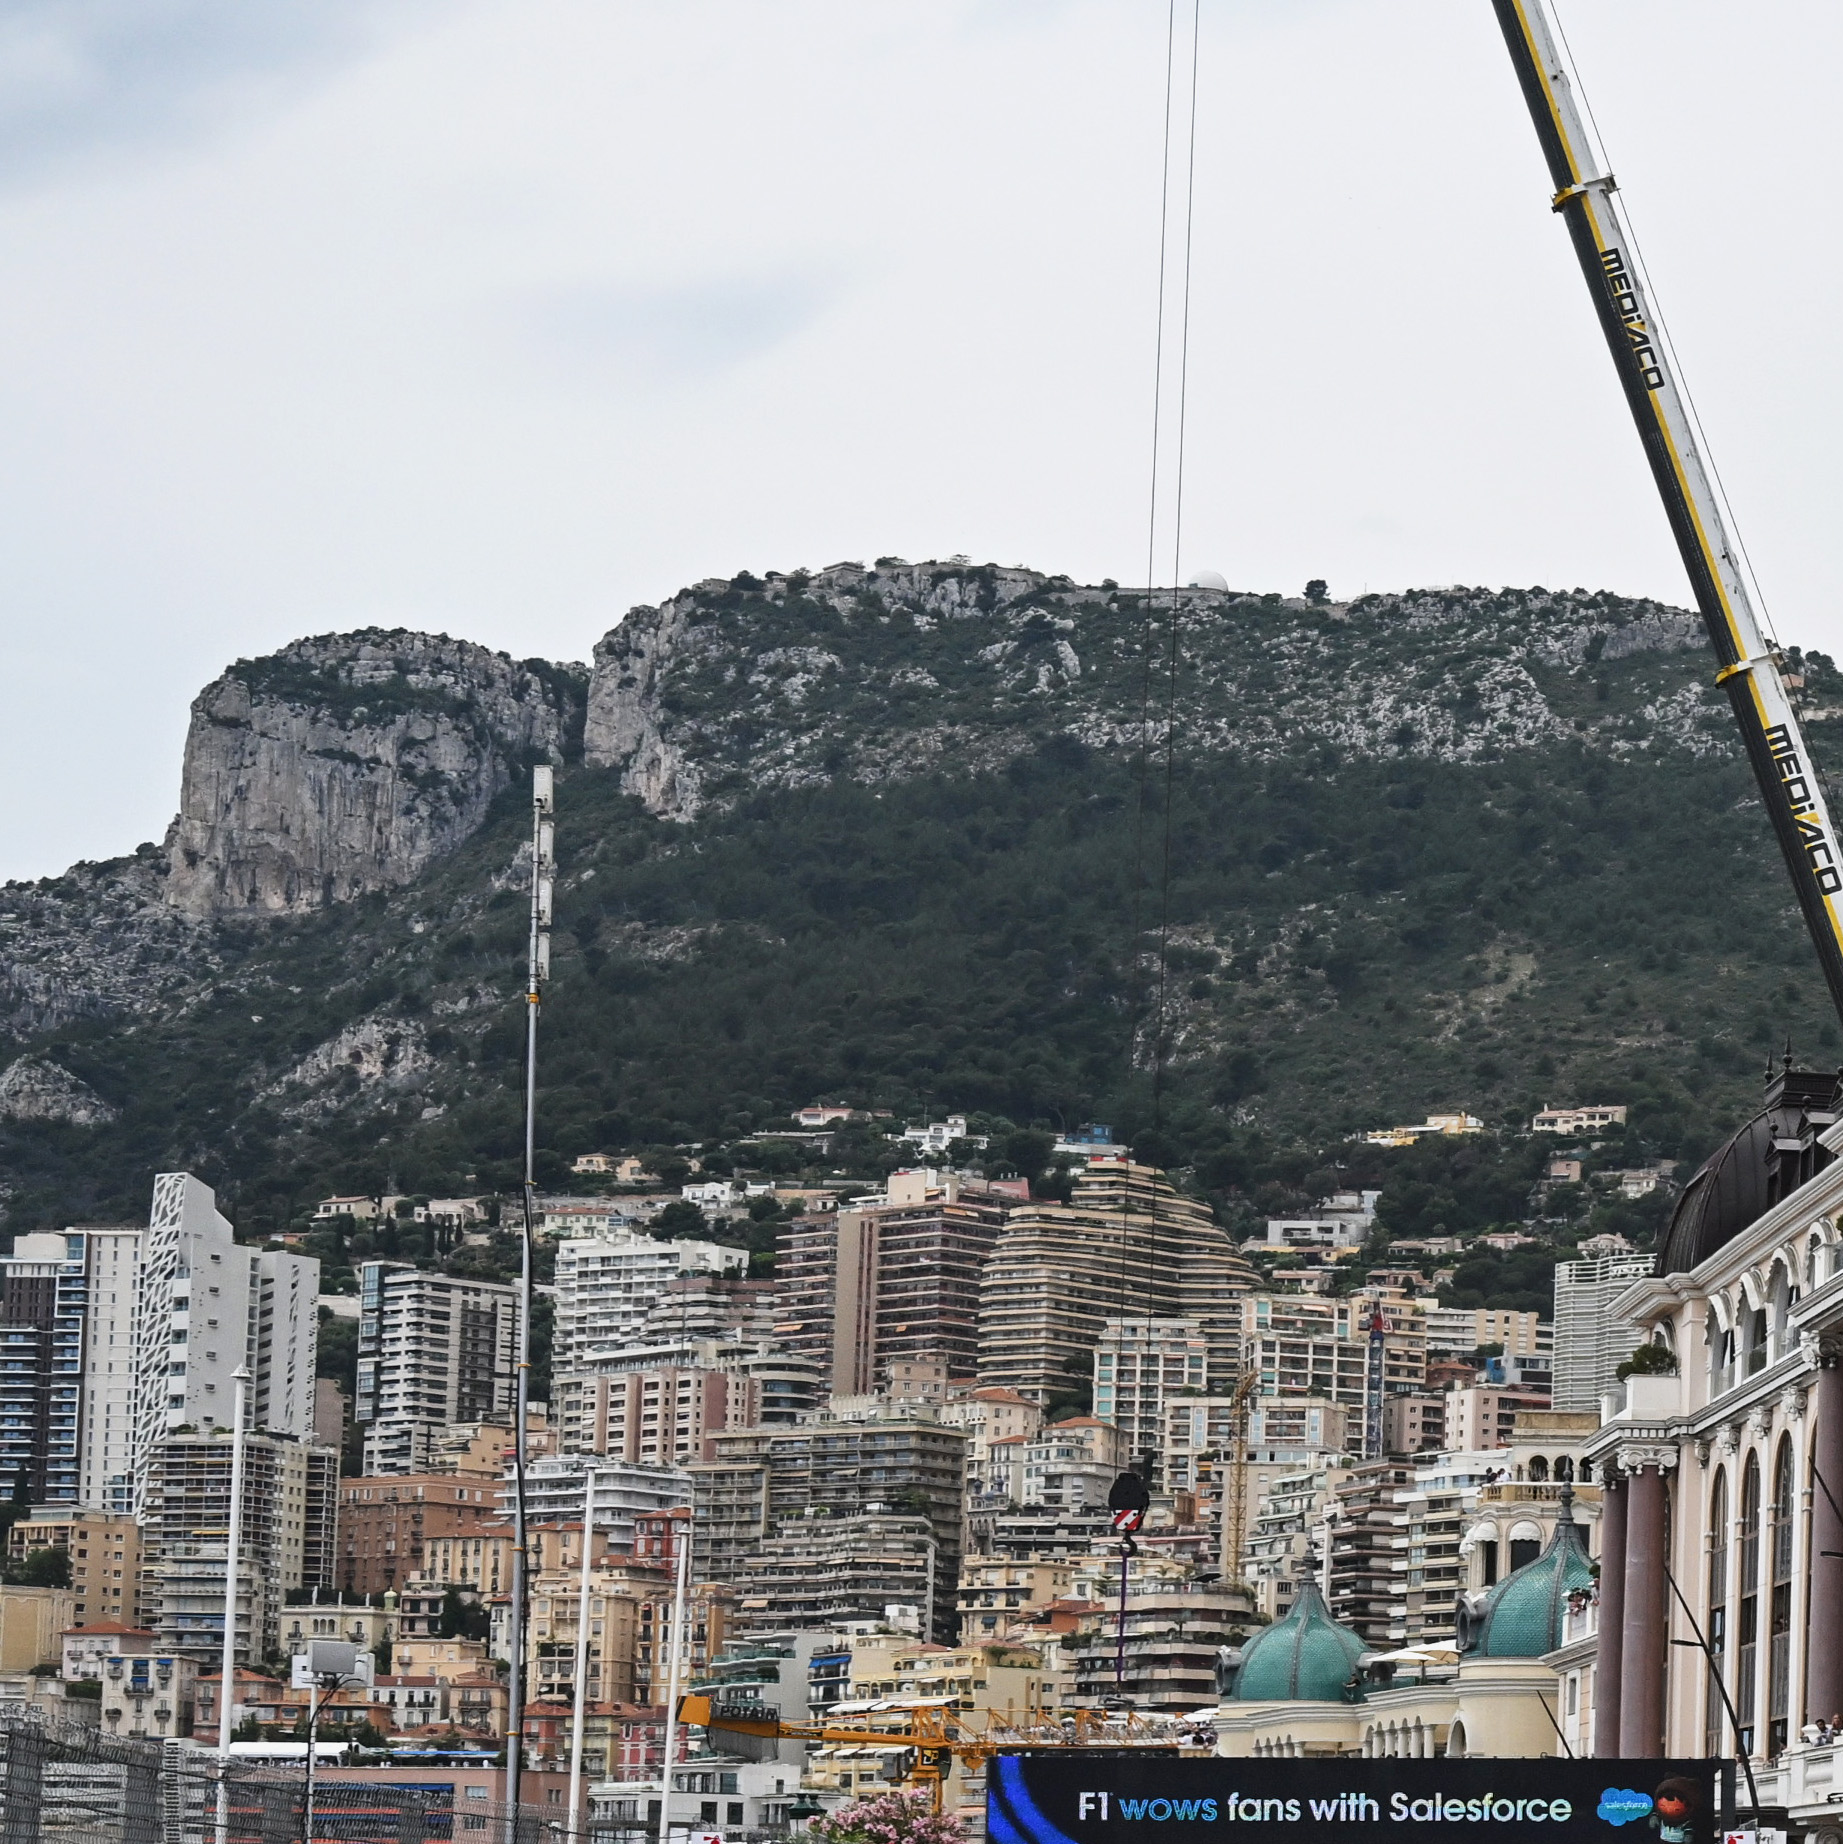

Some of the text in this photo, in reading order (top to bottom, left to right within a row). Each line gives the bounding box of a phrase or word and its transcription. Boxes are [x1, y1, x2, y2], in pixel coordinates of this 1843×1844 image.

[1078, 1790, 1572, 1823] F1 wows fans with Salesforce
